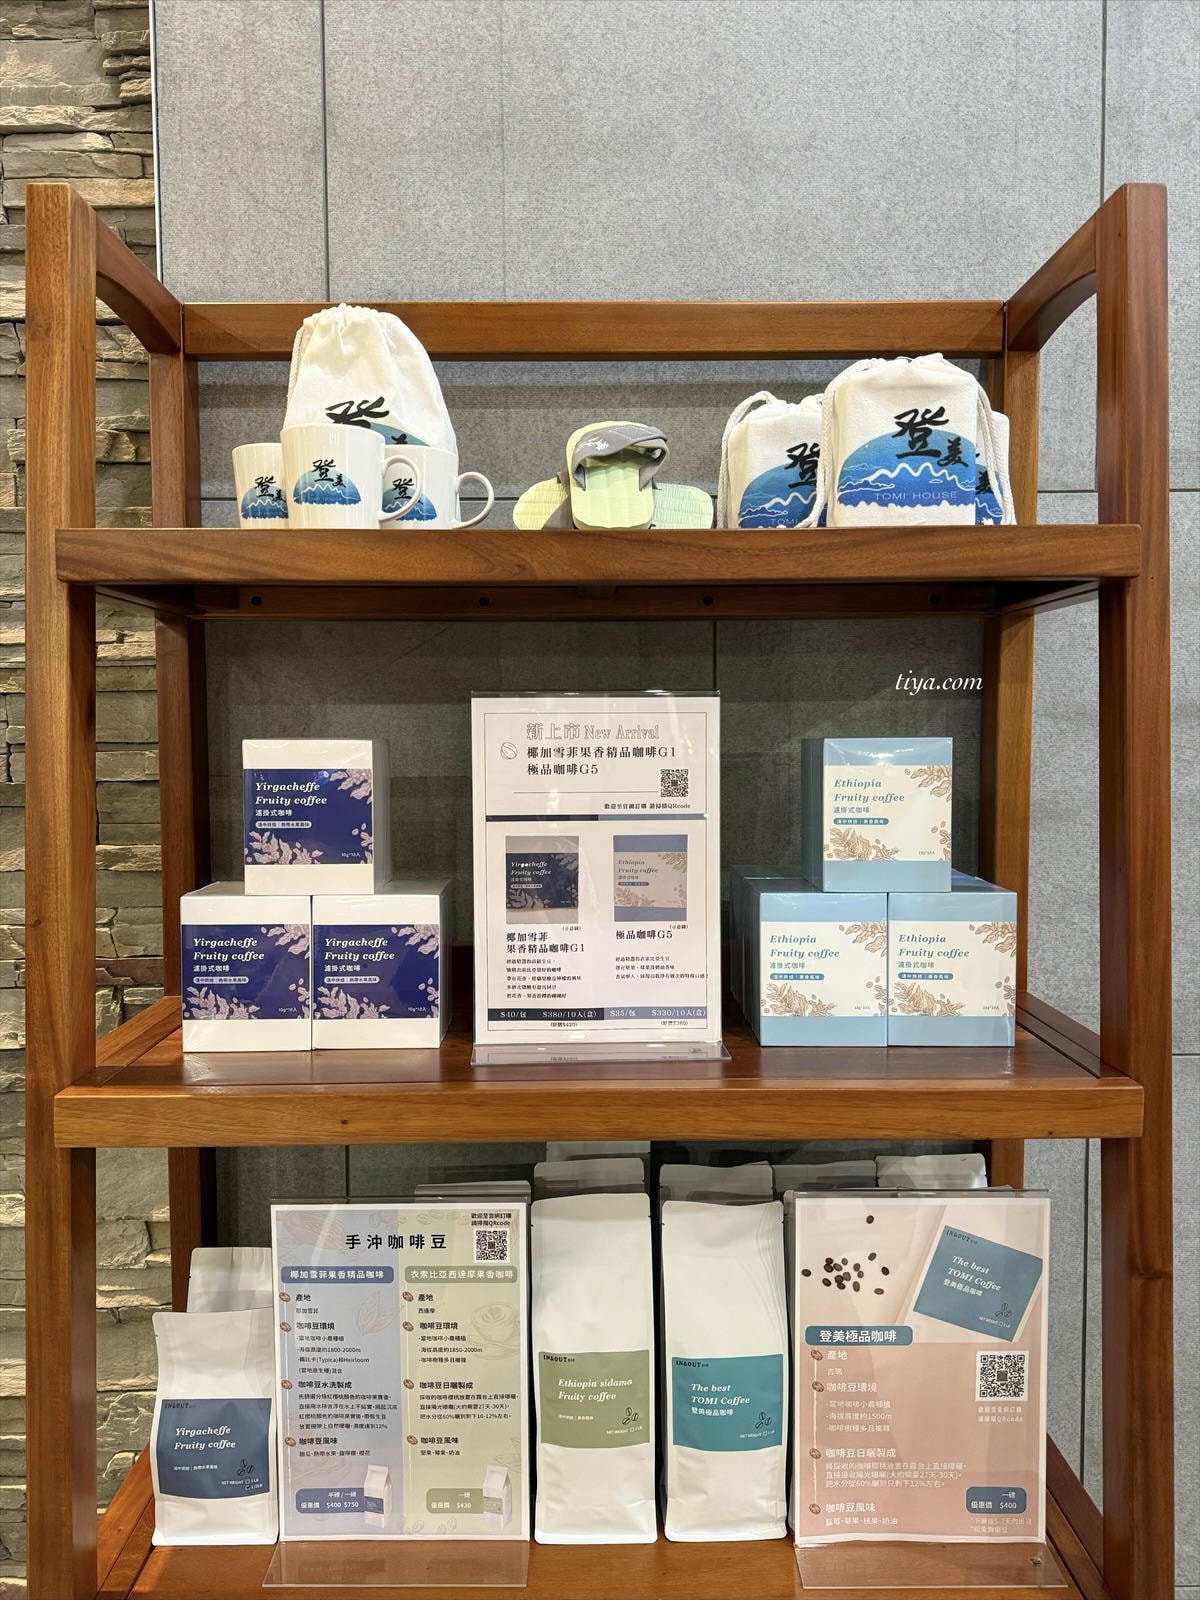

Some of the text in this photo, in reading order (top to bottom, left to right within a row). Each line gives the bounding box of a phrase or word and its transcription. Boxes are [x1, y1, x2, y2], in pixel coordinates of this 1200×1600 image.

[874, 490, 958, 500] TOMI HOUSE
[526, 722, 660, 740] 新上市 New Arrival
[526, 763, 599, 776] 極品咖啡G5
[255, 782, 320, 793] Yirgacheffe
[834, 778, 882, 789] Ethiopia
[254, 796, 328, 806] Fruity coffee
[834, 793, 905, 804] Fruity coffee
[615, 930, 673, 940] 極品咖啡G5
[770, 934, 817, 945] Ethiopia
[898, 934, 946, 944] Ethiopia
[193, 937, 258, 948] Yirgacheffe
[324, 937, 388, 948] Yirgacheffe
[193, 951, 265, 962] Fruity coffee
[324, 950, 395, 961] Fruity coffee
[770, 948, 840, 960] Fruity coffee
[898, 948, 970, 959] Fruity coffee
[345, 1234, 447, 1250] 手沖咖啡豆
[952, 1255, 990, 1275] The best
[947, 1267, 1001, 1291] TOMI Coffee
[295, 1293, 312, 1302] 產地
[418, 1293, 434, 1302] 產地
[296, 1321, 335, 1331] 咖啡豆環境
[419, 1321, 459, 1331] 咖啡豆環境
[819, 1330, 897, 1343] 登美極品咖啡
[543, 1354, 568, 1363] IN&OUT
[826, 1350, 848, 1360] 產地
[675, 1360, 702, 1368] IN&OUT
[558, 1378, 633, 1390] Ethiopia sidama
[691, 1383, 731, 1392] The best
[826, 1382, 878, 1393] 咖啡豆環境
[558, 1391, 617, 1402] Fruity coffee
[691, 1396, 751, 1406] TOMI Coffee
[175, 1425, 231, 1438] Yirgacheffe
[174, 1439, 236, 1451] Fruity coffee
[298, 1437, 338, 1446] 咖啡豆風味
[420, 1436, 459, 1445] 咖啡豆風味
[825, 1502, 878, 1513] 咖啡豆風味
[999, 1502, 1017, 1510] $400
